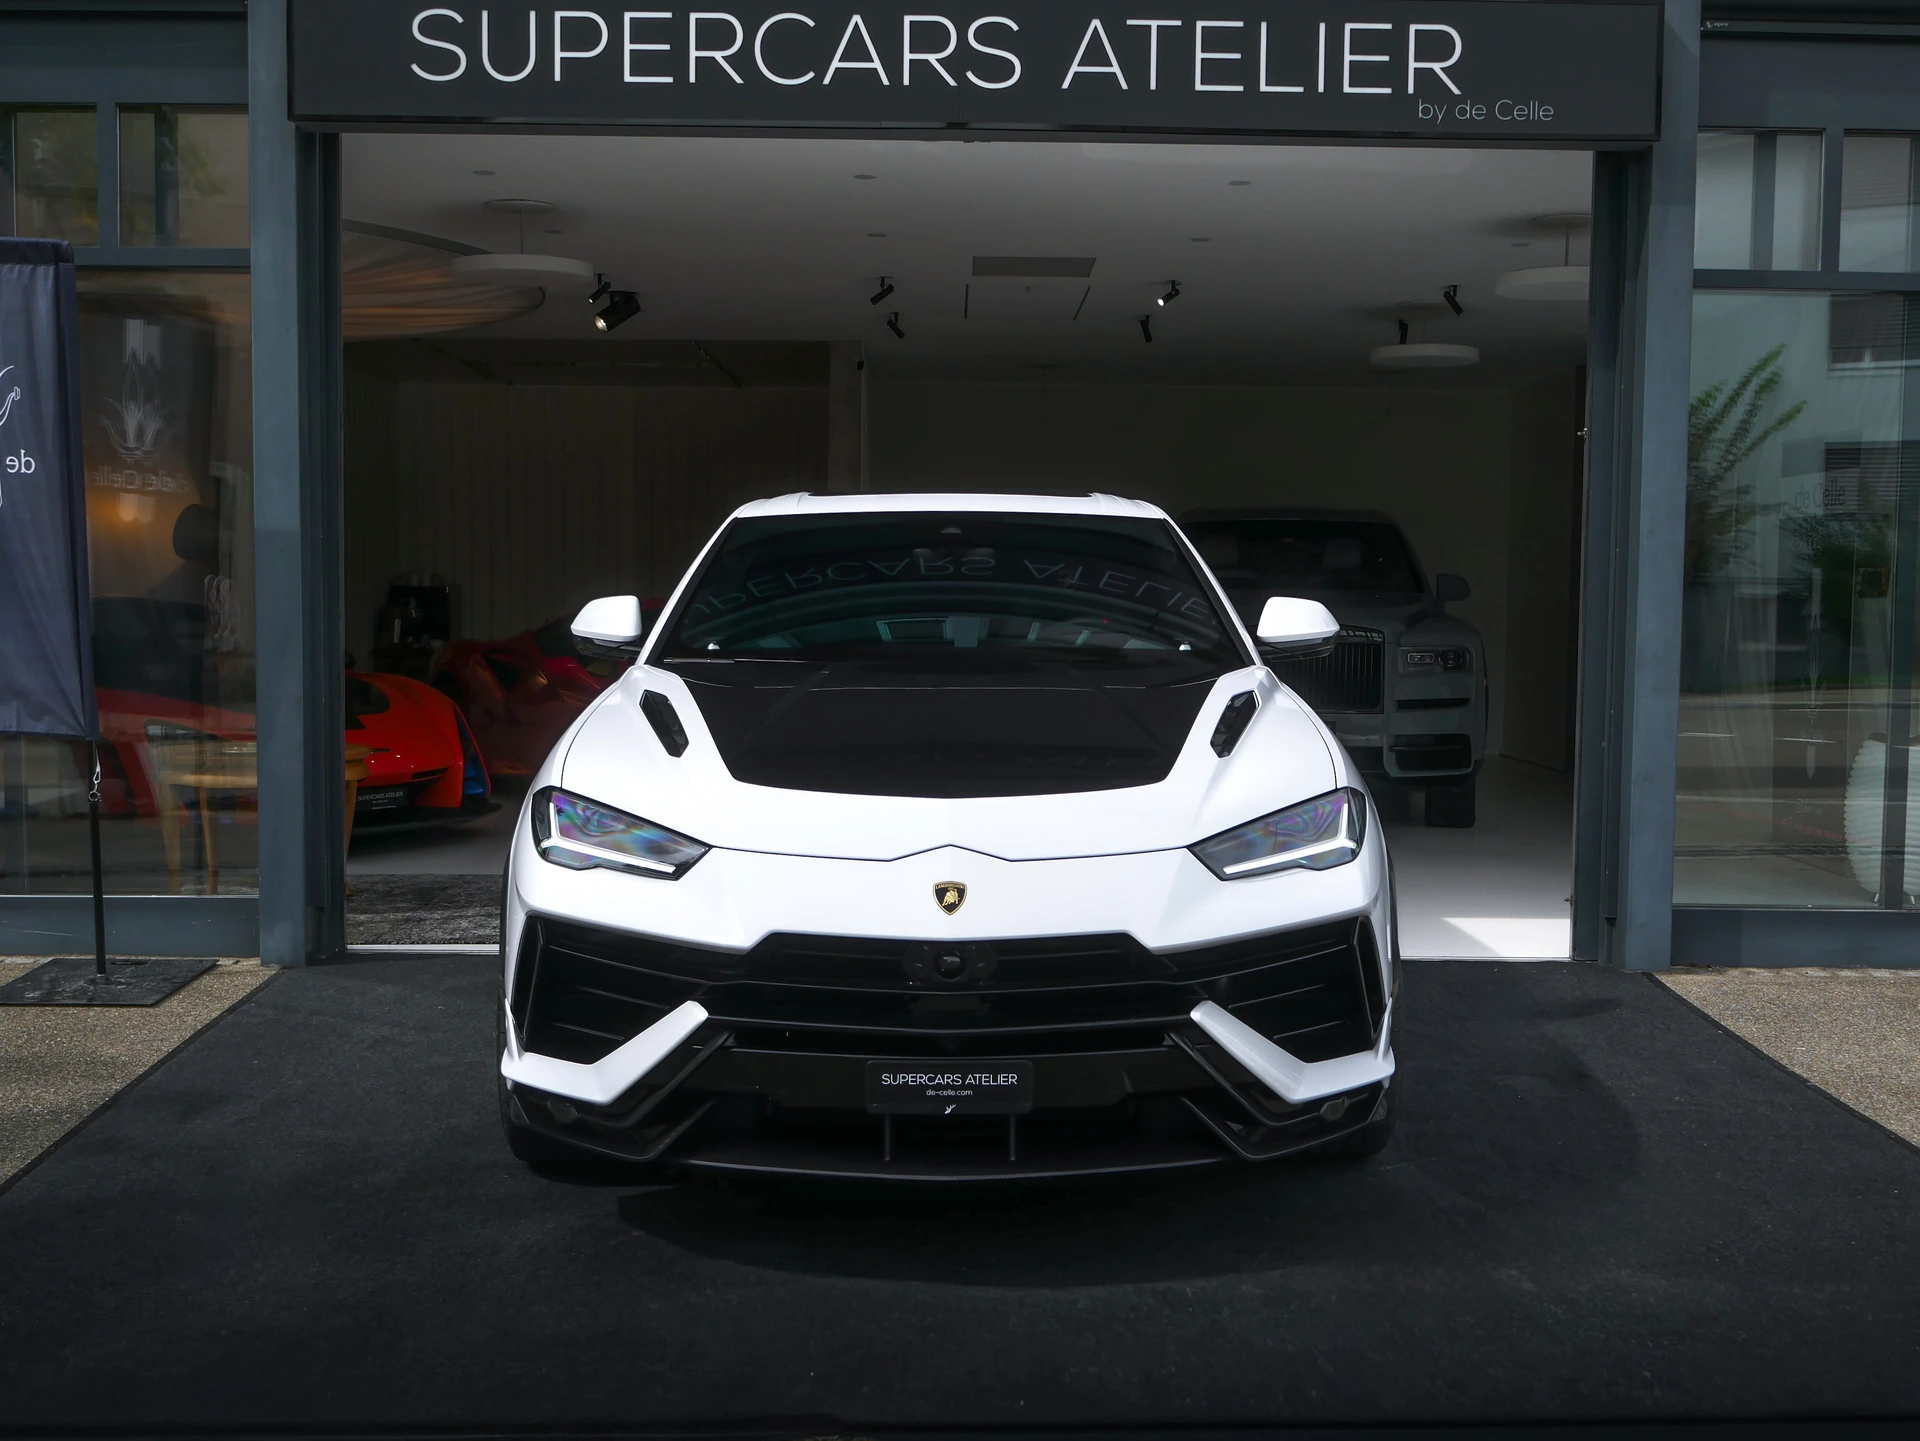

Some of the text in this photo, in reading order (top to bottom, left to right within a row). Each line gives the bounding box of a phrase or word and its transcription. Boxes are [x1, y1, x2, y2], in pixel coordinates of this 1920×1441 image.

[409, 7, 1464, 95] SUPERCARS ATELIER
[1418, 98, 1555, 125] by de Celle
[1794, 475, 1847, 511] de Celle
[881, 1073, 1019, 1086] SUPERCARS ATELIER
[925, 1088, 974, 1097] de-celle.com
